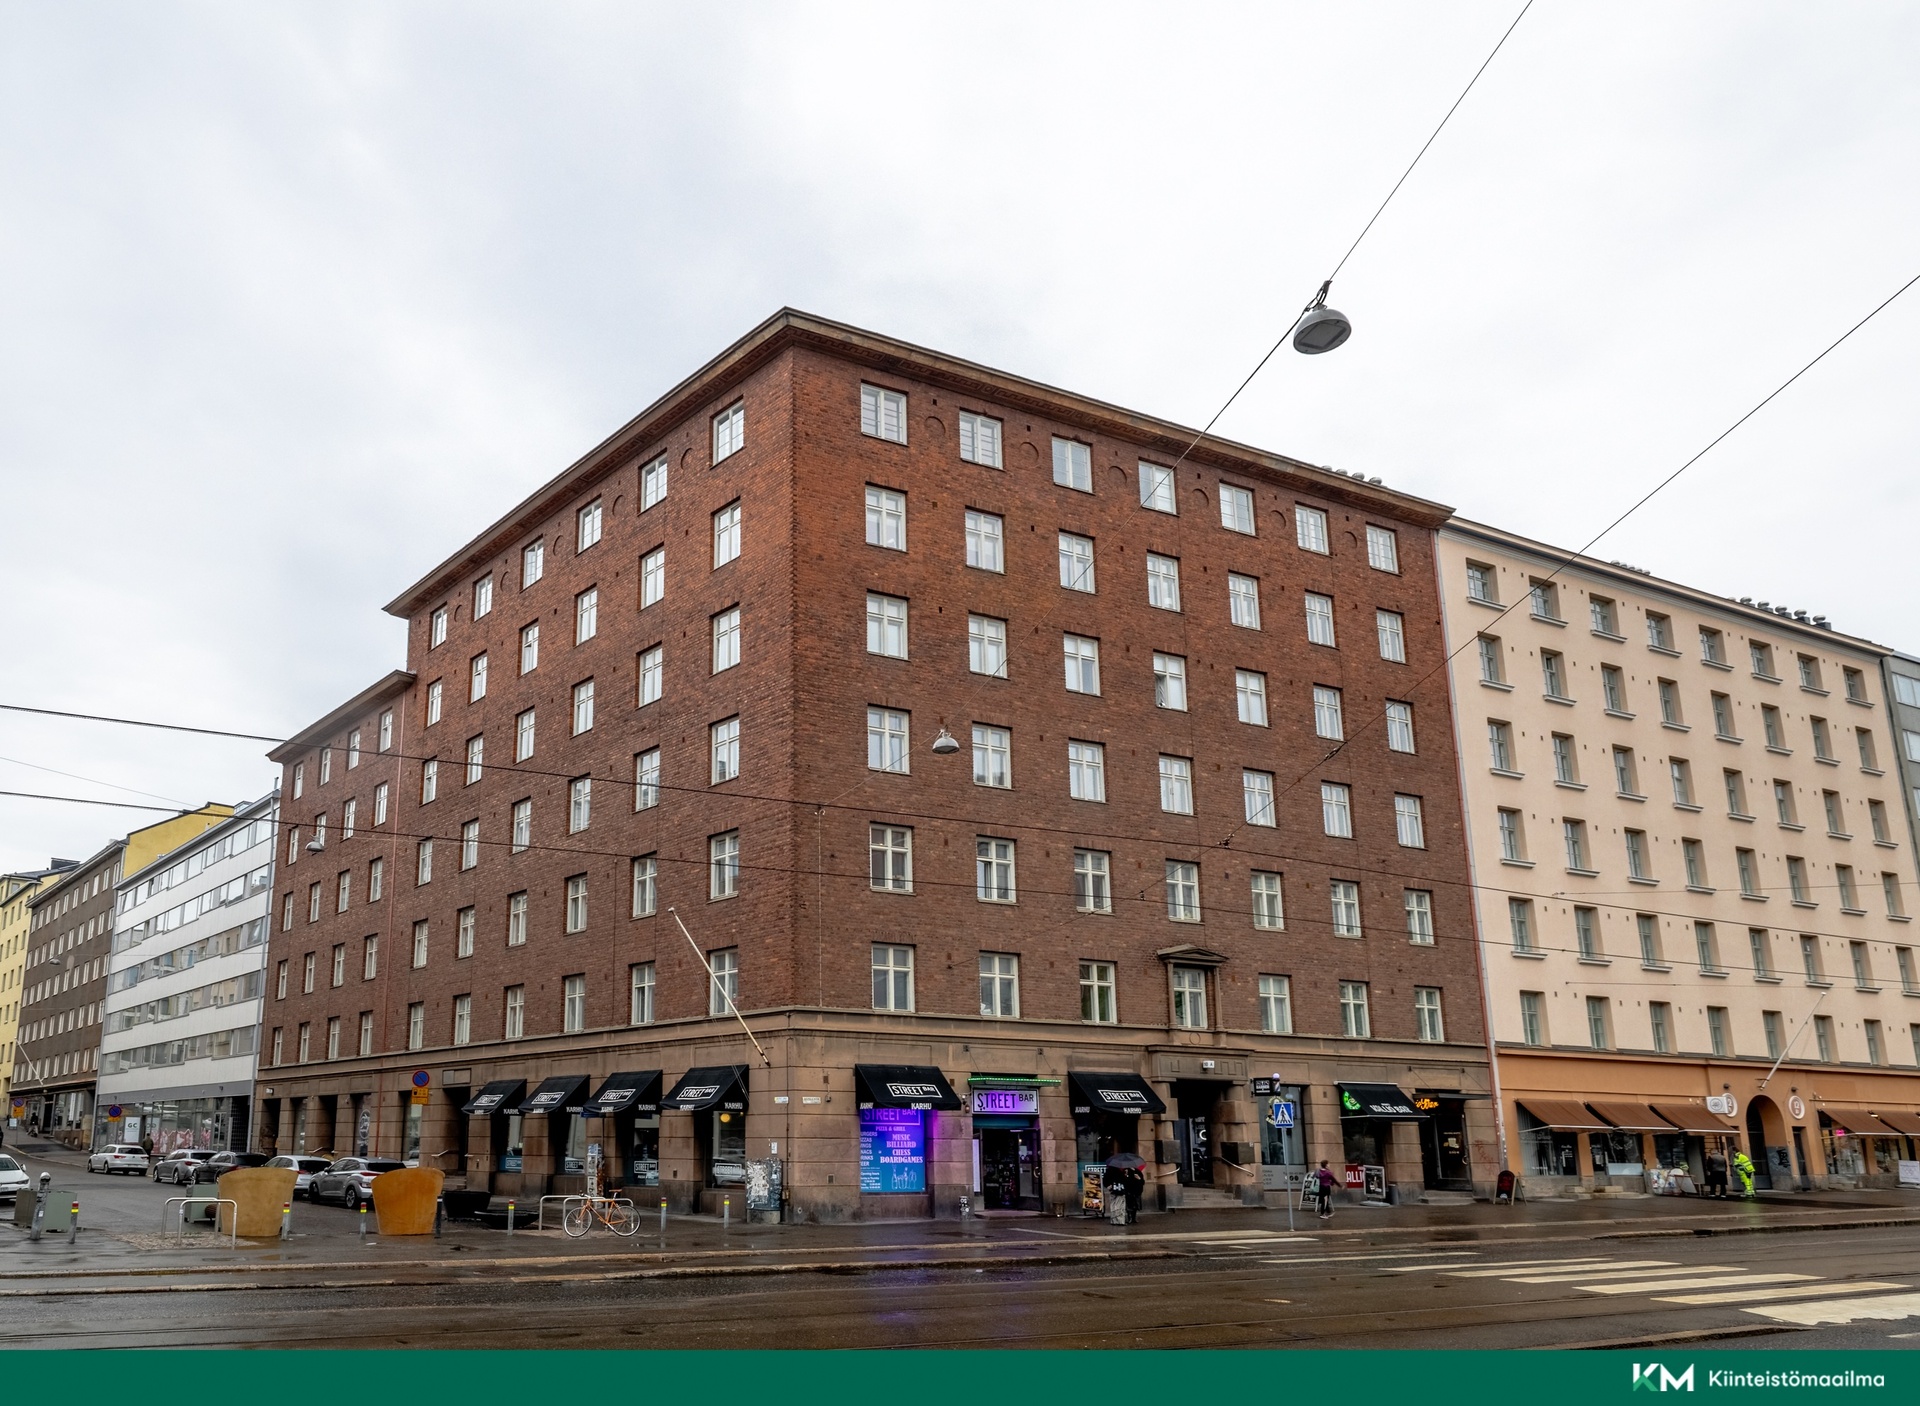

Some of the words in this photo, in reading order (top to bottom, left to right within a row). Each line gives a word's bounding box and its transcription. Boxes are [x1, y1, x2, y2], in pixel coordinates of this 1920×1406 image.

[680, 1087, 706, 1098] STREET
[891, 1085, 924, 1095] STREET
[603, 1091, 624, 1100] STREET
[977, 1092, 1017, 1109] STREET
[1018, 1093, 1034, 1102] BAR
[1104, 1091, 1132, 1101] STREET
[911, 1102, 932, 1110] KARHU
[864, 1108, 901, 1121] STREET
[636, 1163, 650, 1171] STREET
[1346, 1171, 1364, 1183] ALLI
